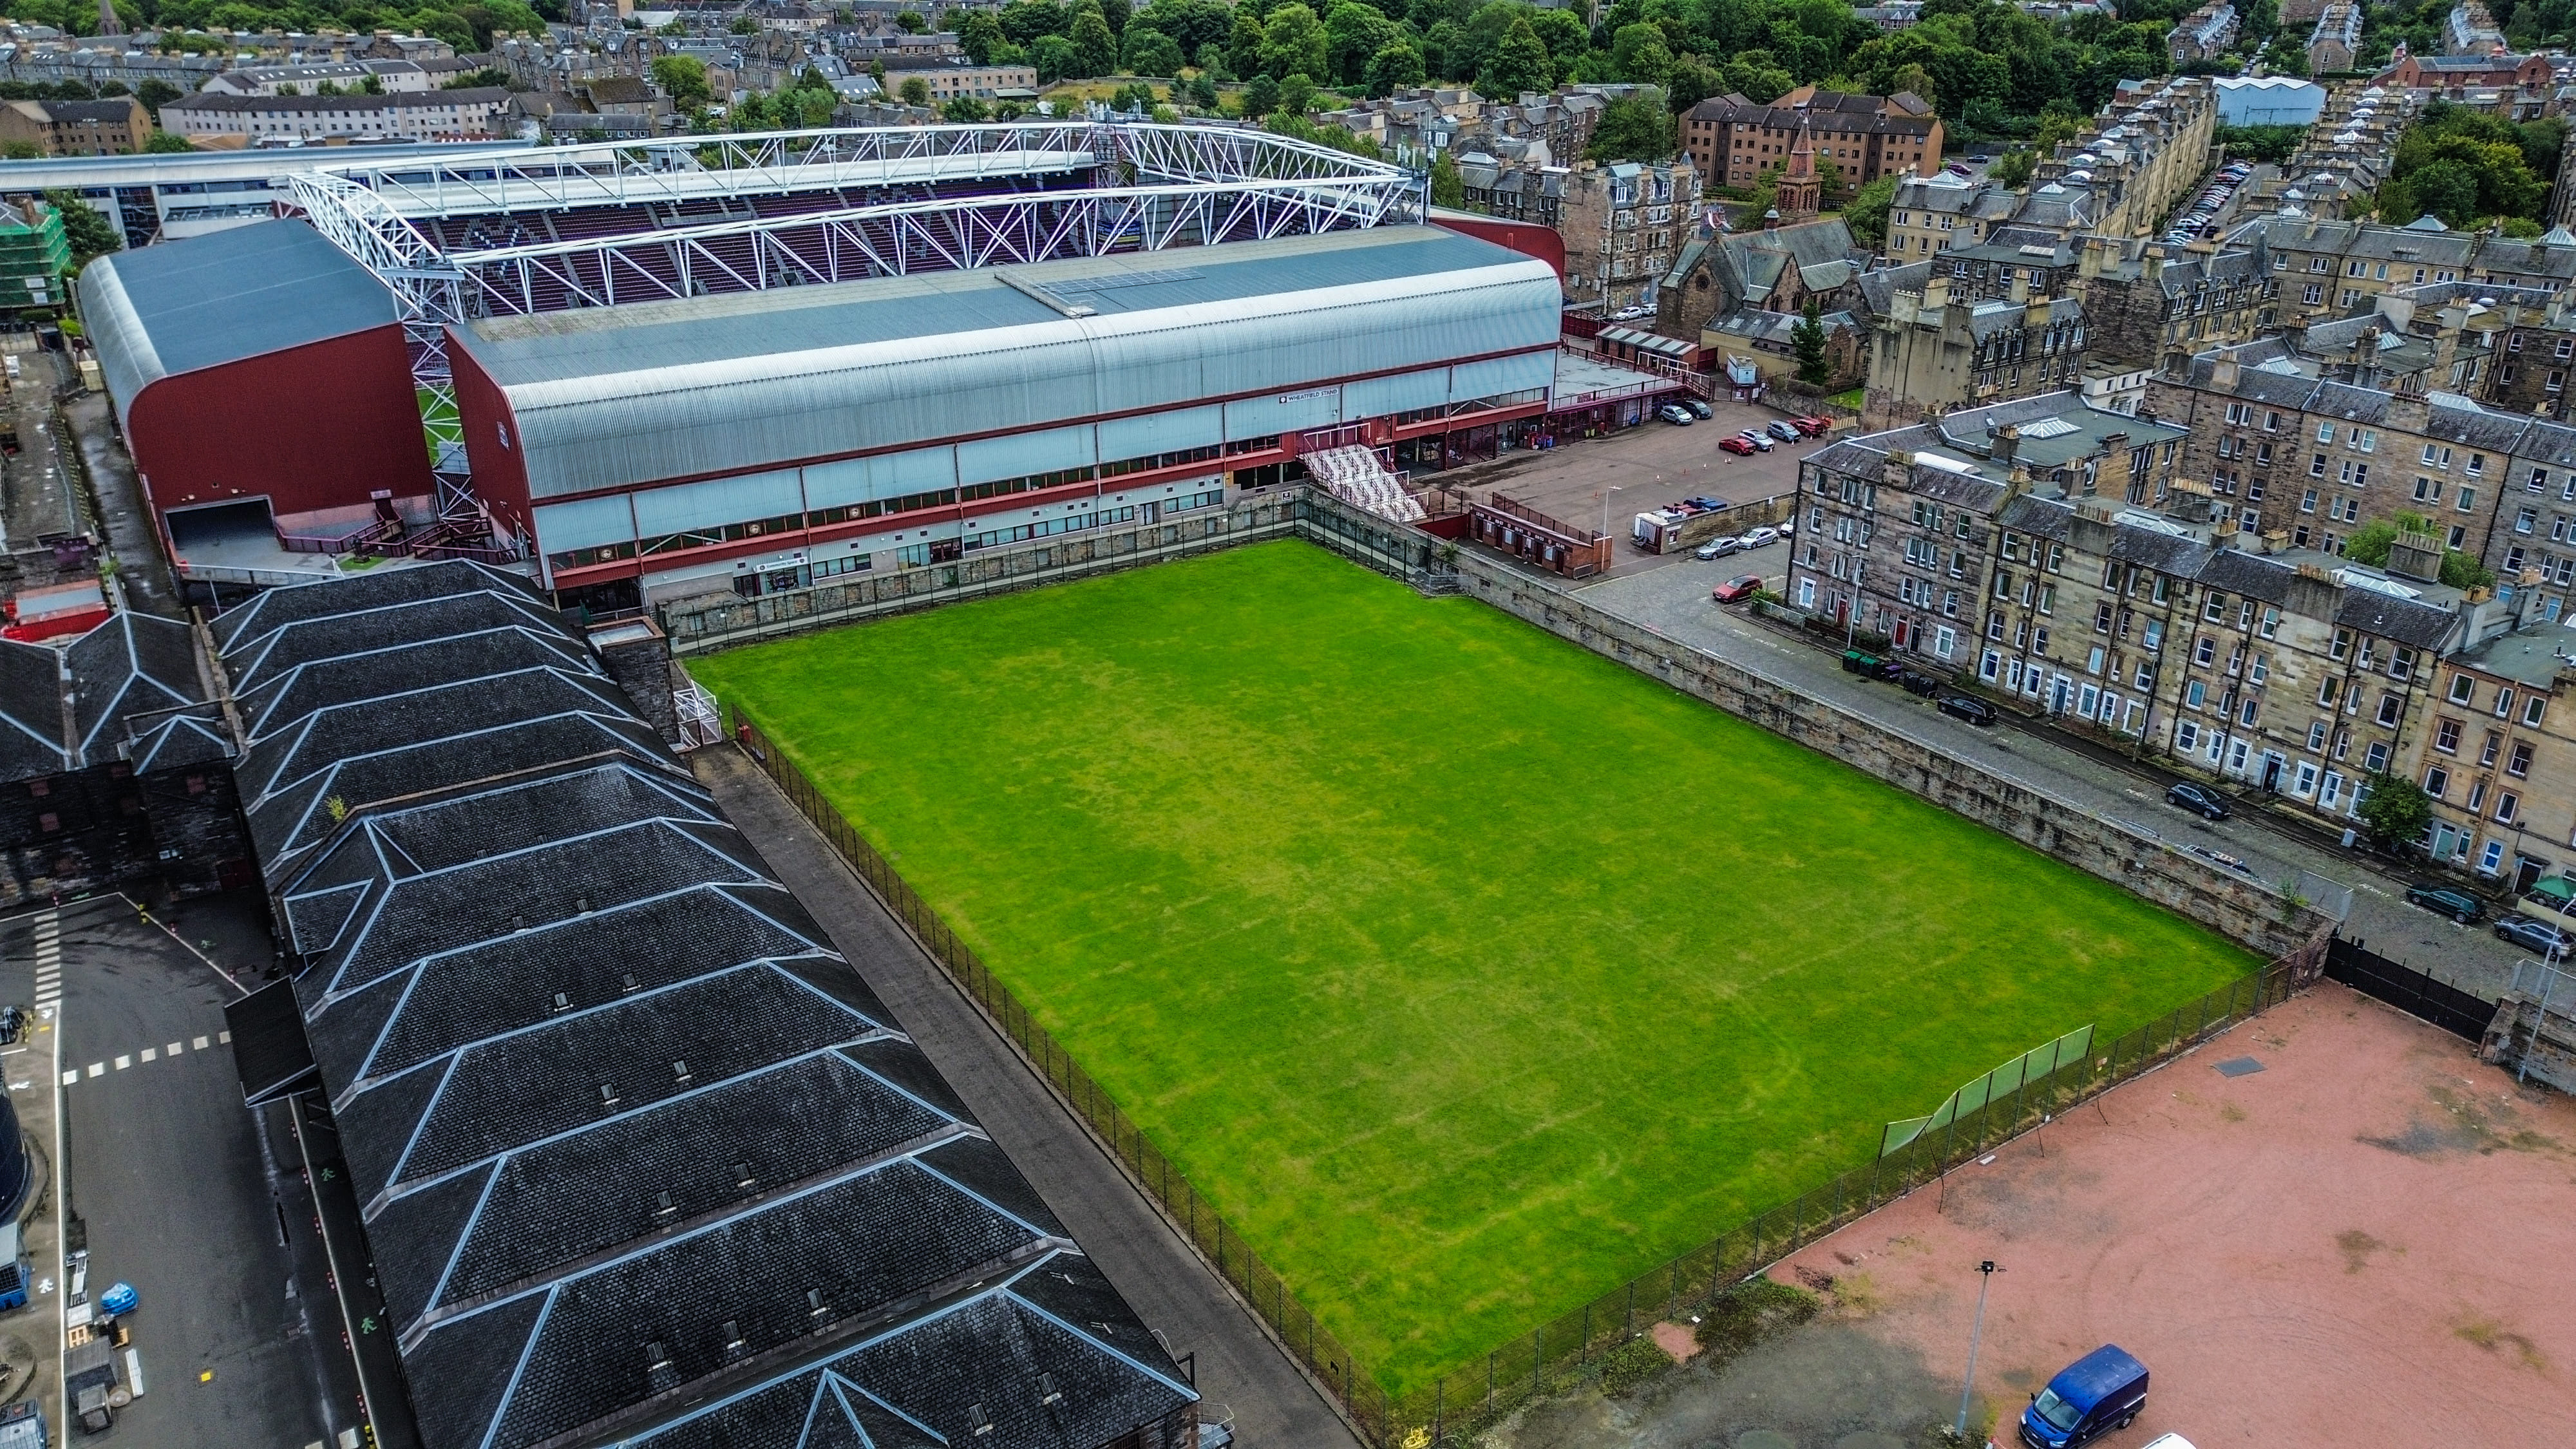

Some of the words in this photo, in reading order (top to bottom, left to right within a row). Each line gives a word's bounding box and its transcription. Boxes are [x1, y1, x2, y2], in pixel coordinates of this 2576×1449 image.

[1288, 392, 1320, 401] WHEATFIELD
[2358, 883, 2392, 898] PERMIT
[2400, 900, 2441, 918] HOLDERS
[2450, 920, 2475, 932] ONLY
